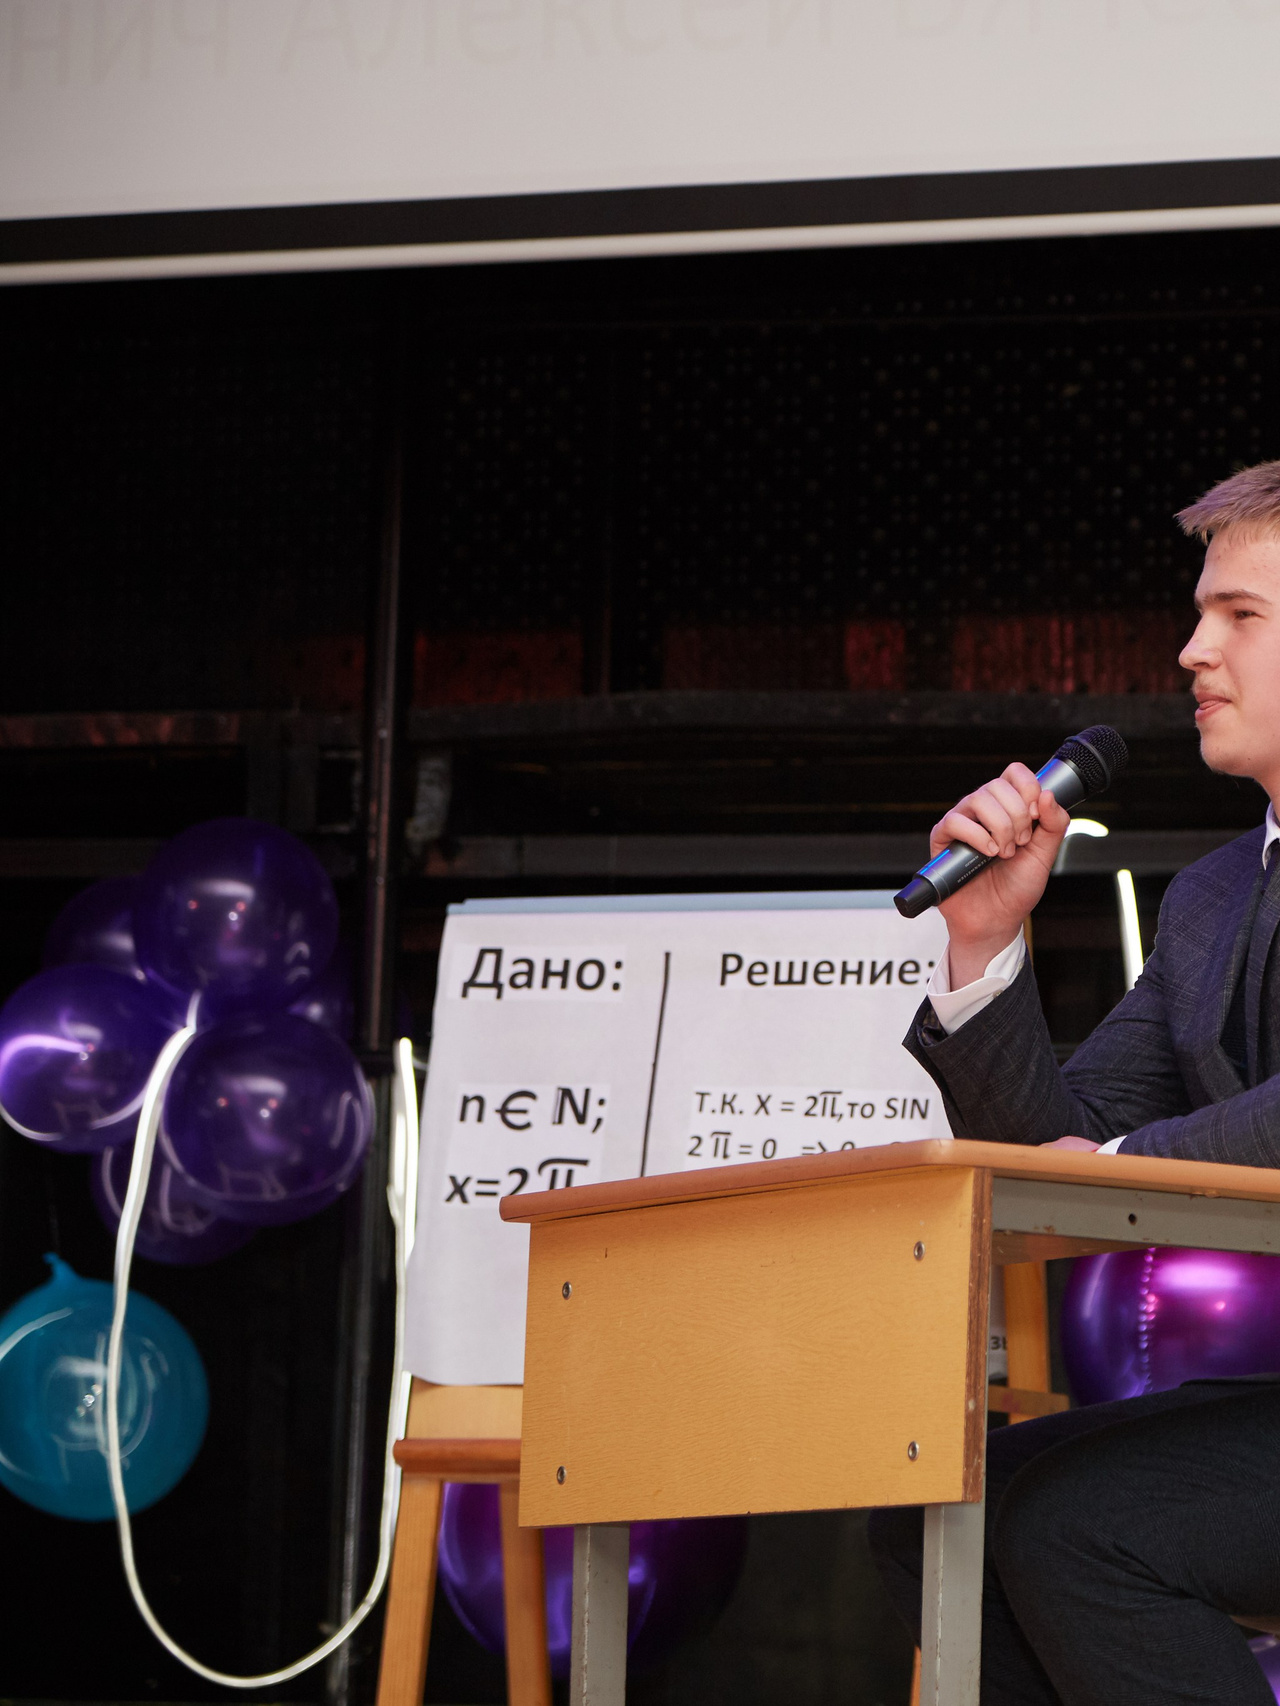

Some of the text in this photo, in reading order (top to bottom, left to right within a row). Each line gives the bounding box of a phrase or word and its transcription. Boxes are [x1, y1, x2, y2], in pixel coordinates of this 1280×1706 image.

[461, 948, 622, 999] Дано:
[719, 953, 935, 986] Решение:
[884, 1097, 929, 1120] SIN
